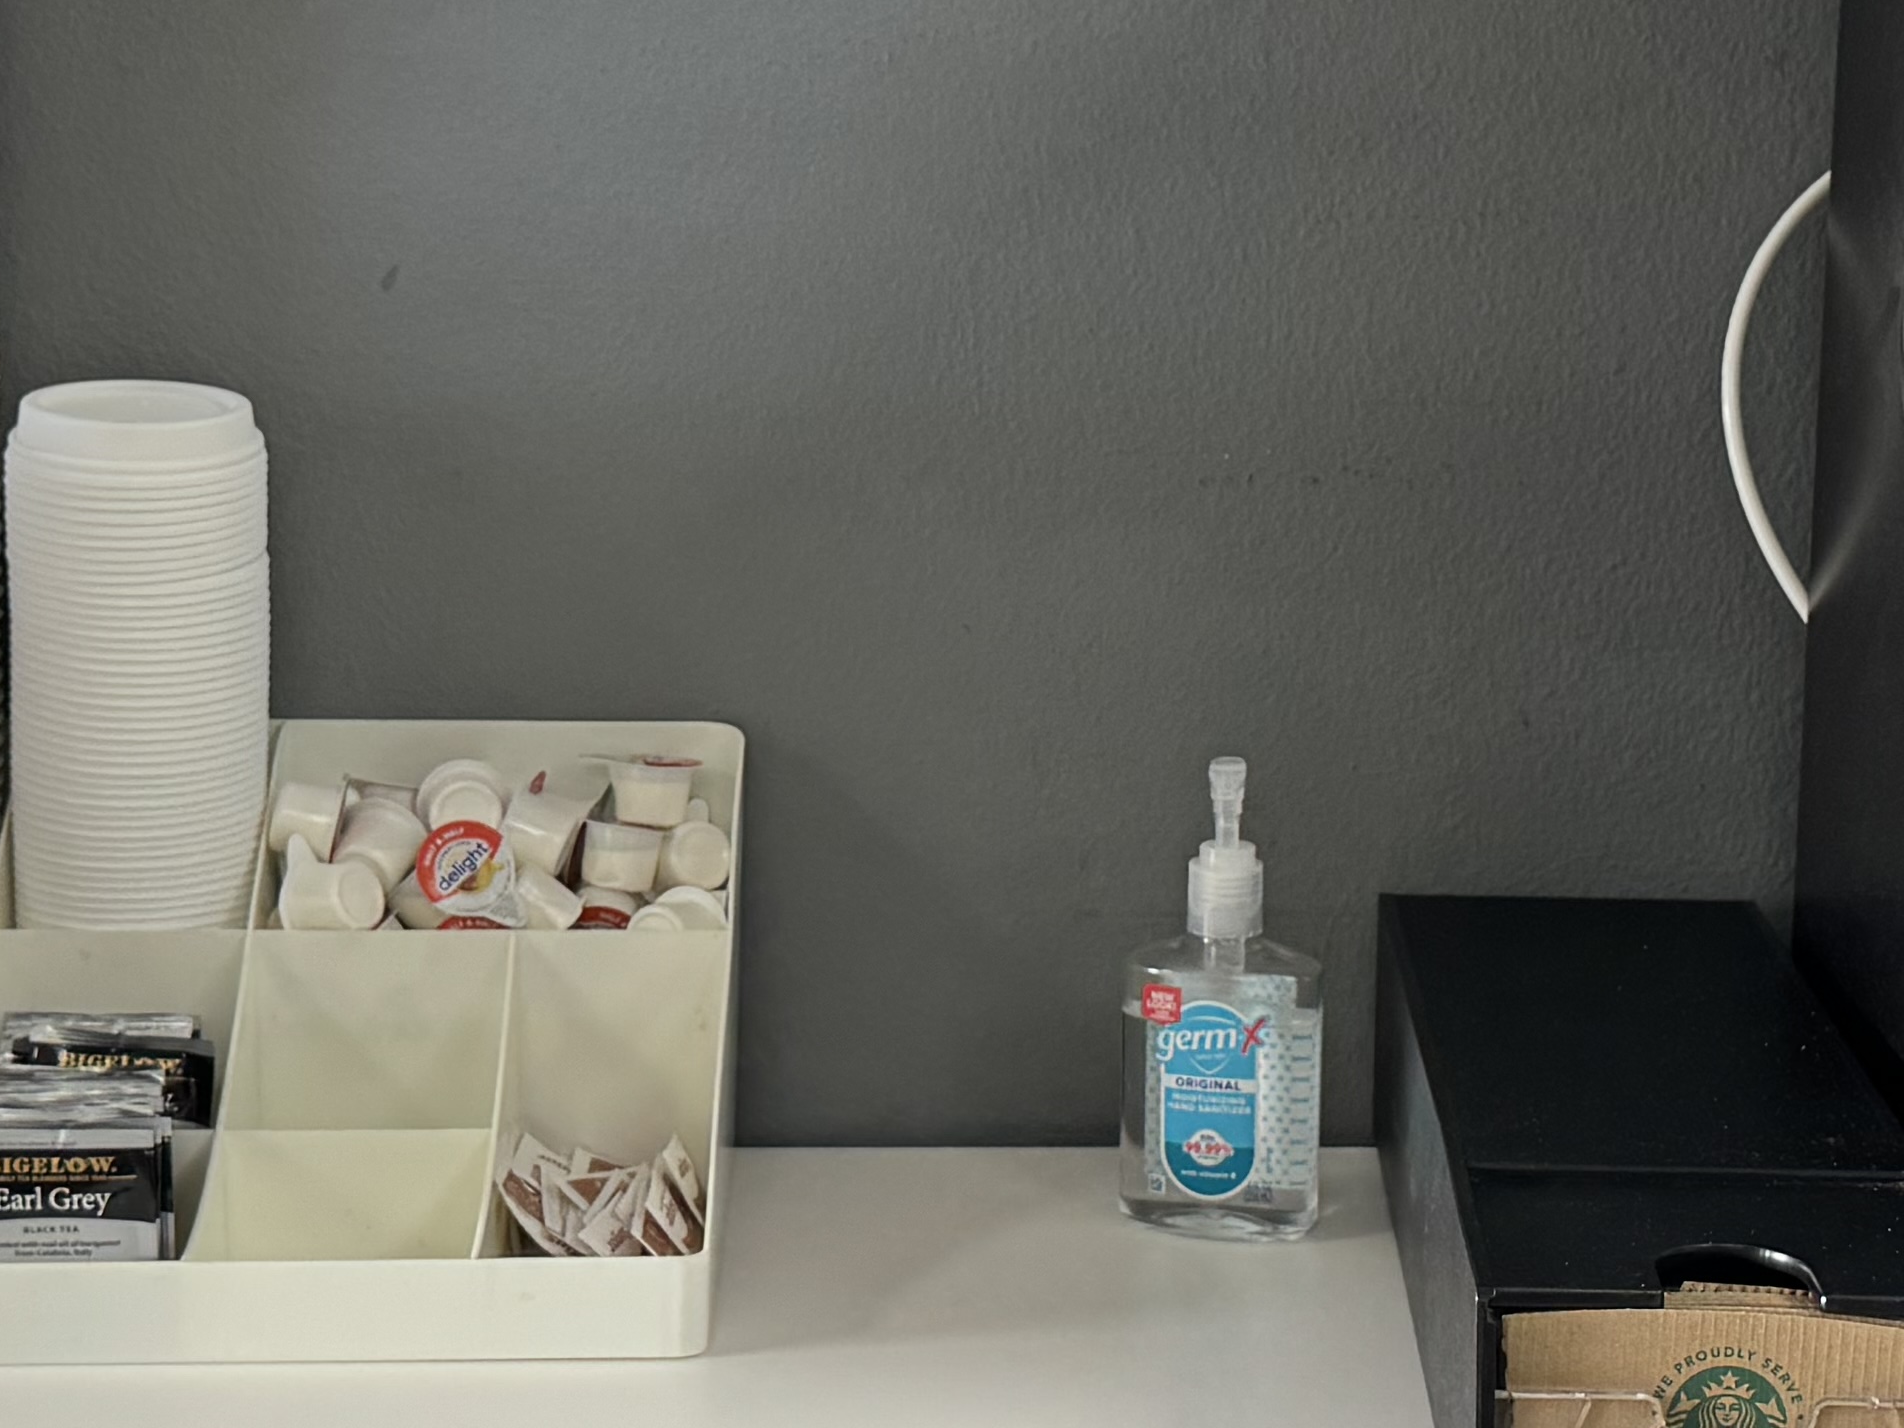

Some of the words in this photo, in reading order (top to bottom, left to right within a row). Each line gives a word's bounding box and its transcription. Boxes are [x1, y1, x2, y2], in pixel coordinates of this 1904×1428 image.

[439, 842, 489, 891] delight
[1175, 1076, 1241, 1091] ORIGINAL
[48, 1186, 113, 1217] Grey
[22, 1225, 57, 1234] BLACK
[59, 1225, 81, 1233] TEA
[1652, 1375, 1674, 1400] WE
[1673, 1346, 1757, 1375] PROUDLY
[1761, 1357, 1805, 1404] SERVE
